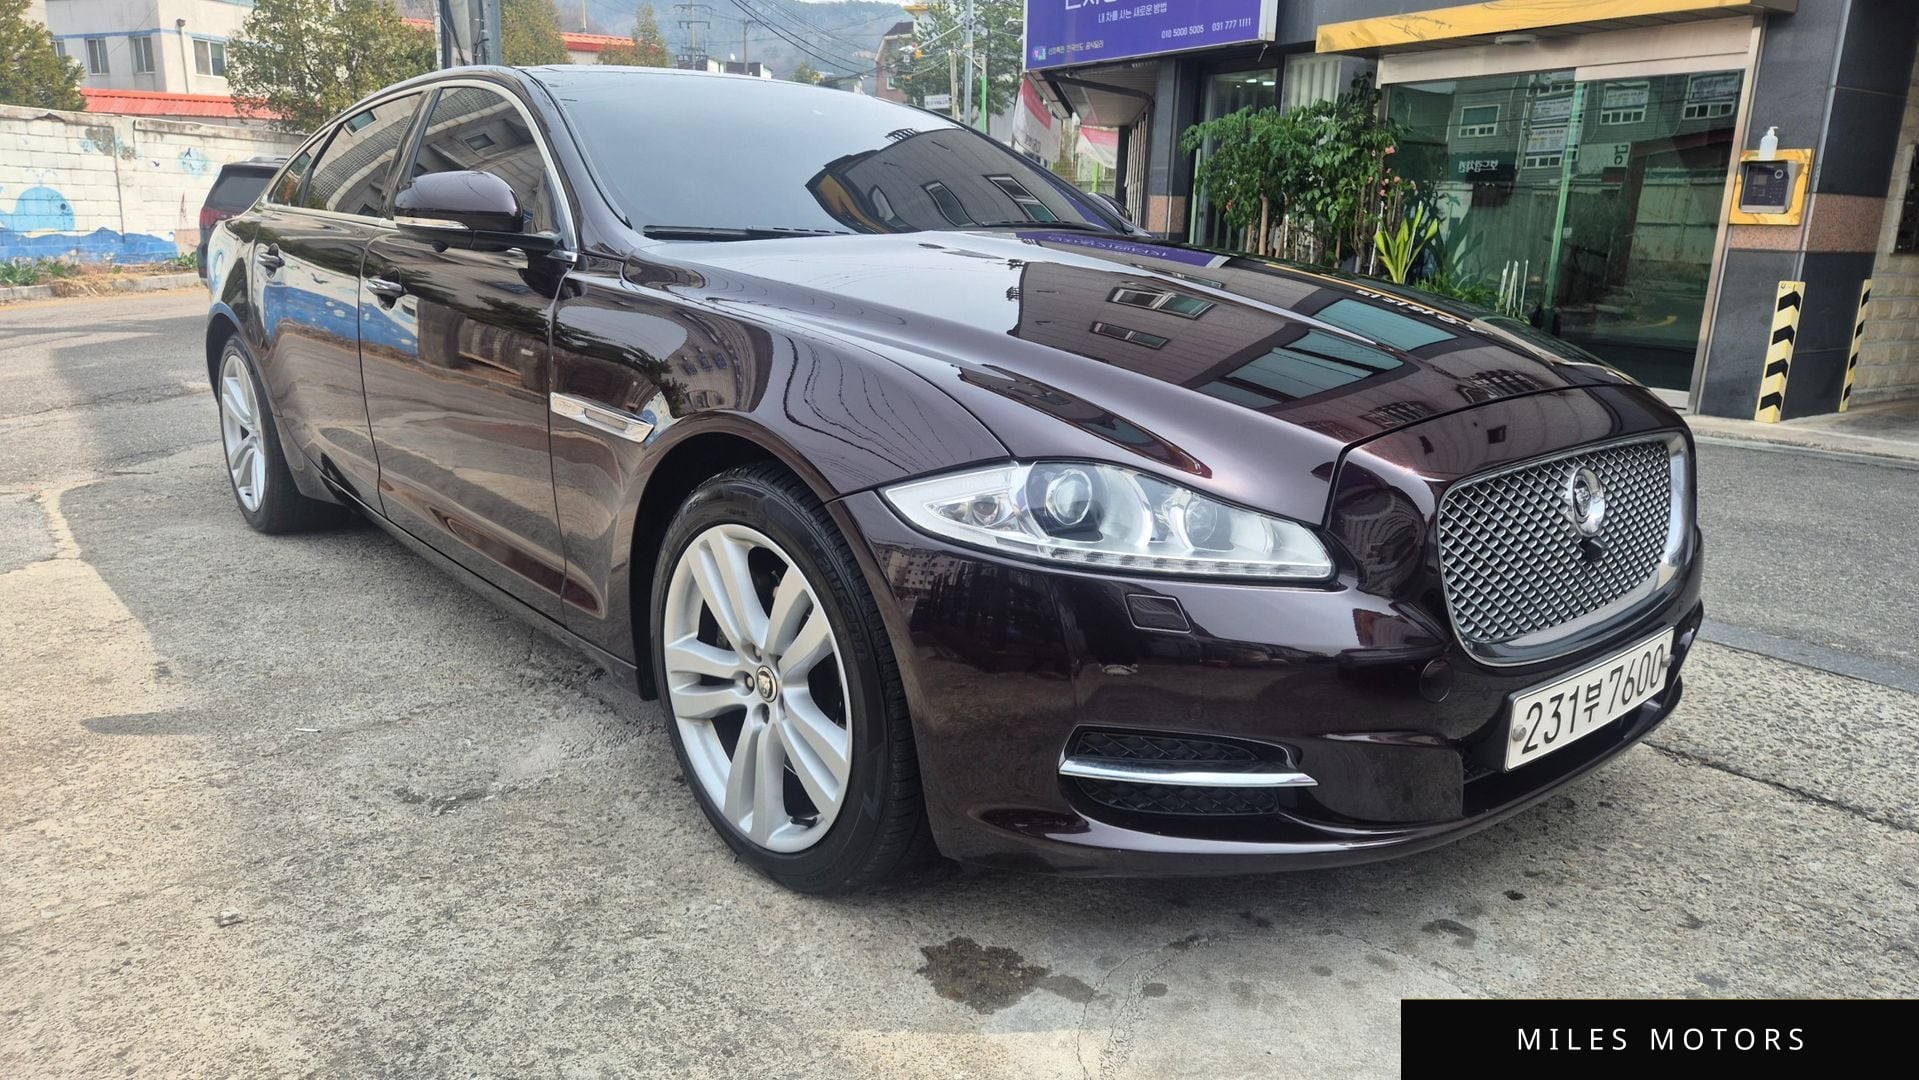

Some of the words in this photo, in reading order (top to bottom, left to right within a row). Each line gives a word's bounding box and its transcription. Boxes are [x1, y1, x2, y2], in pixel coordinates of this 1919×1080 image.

[1119, 9, 1132, 20] 사는
[1133, 4, 1153, 17] 새로운
[1153, 2, 1168, 14] 방법
[1161, 29, 1172, 39] 010
[1211, 21, 1223, 32] 031
[1224, 19, 1237, 30] 777
[1239, 17, 1252, 28] 1111
